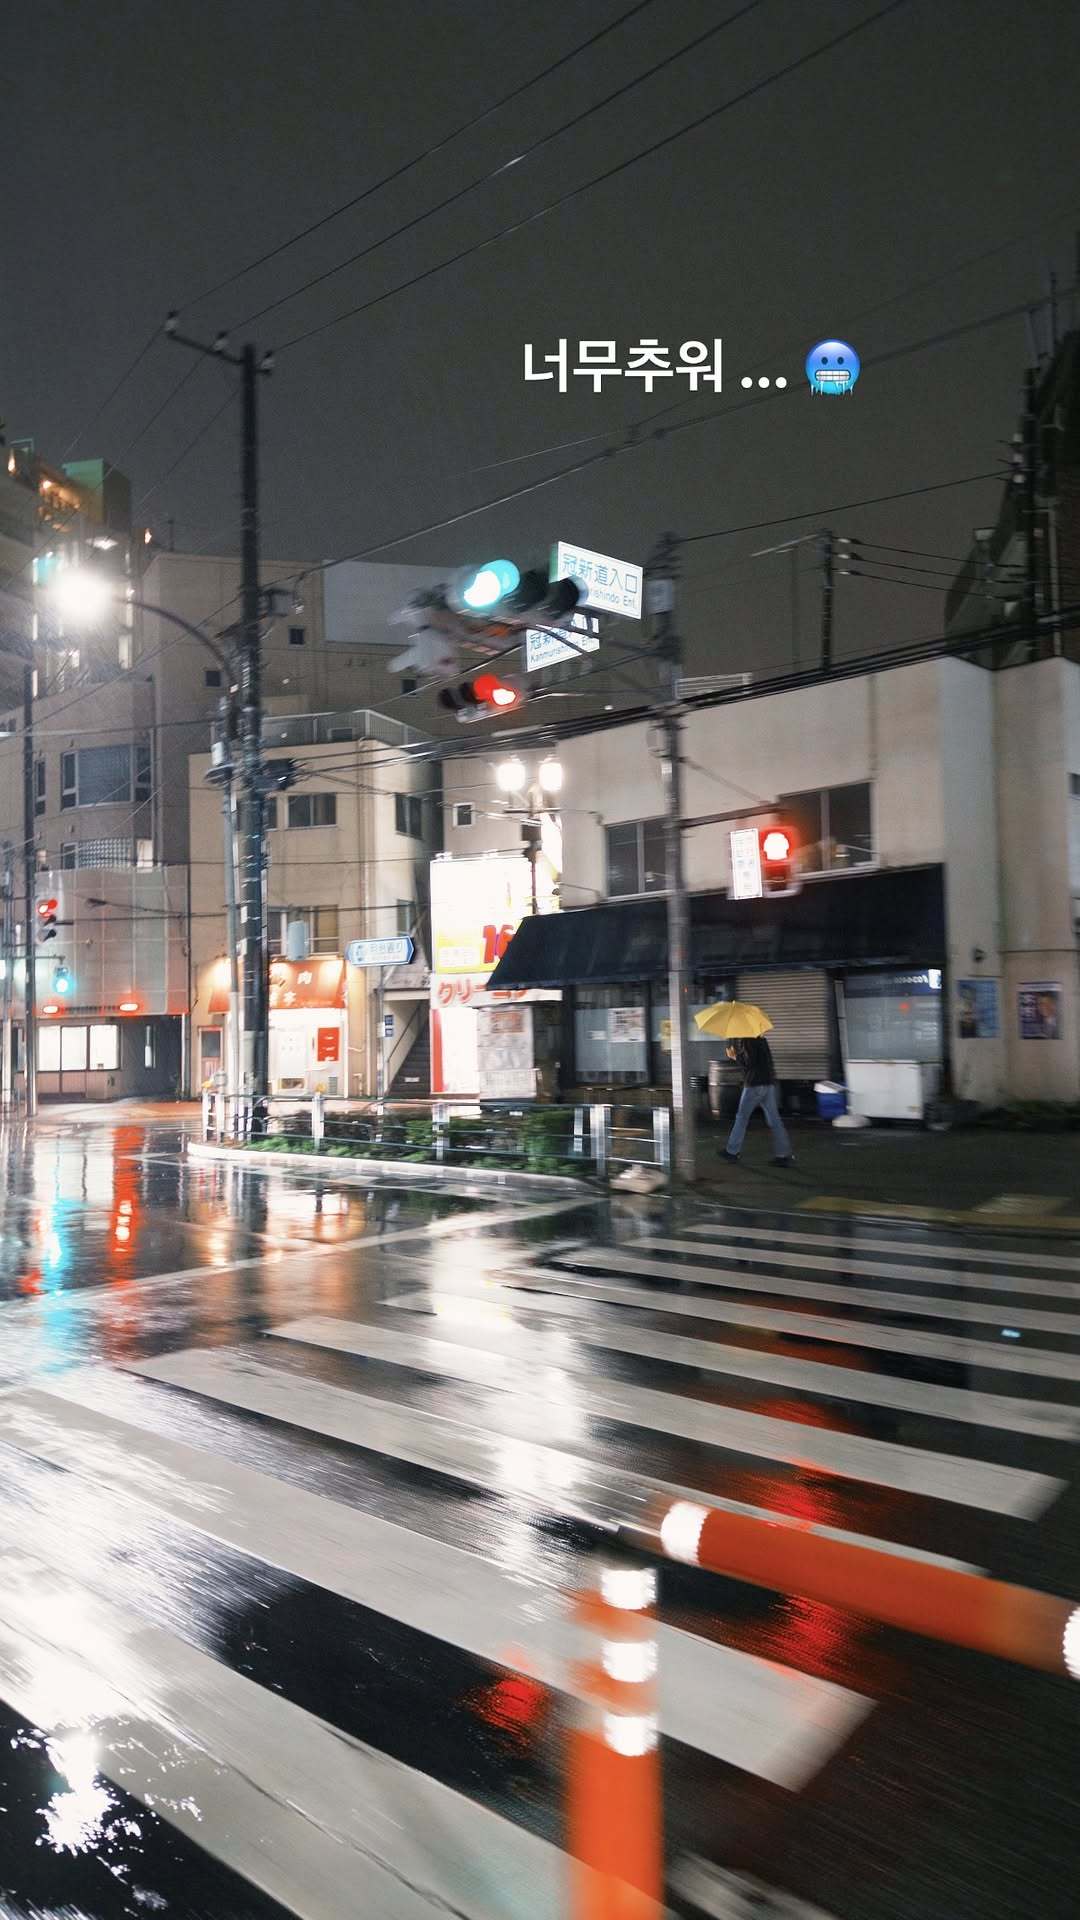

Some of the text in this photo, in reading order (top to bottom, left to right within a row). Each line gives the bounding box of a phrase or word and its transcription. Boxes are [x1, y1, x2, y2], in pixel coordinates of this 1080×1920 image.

[562, 553, 638, 594] 冠新道入口
